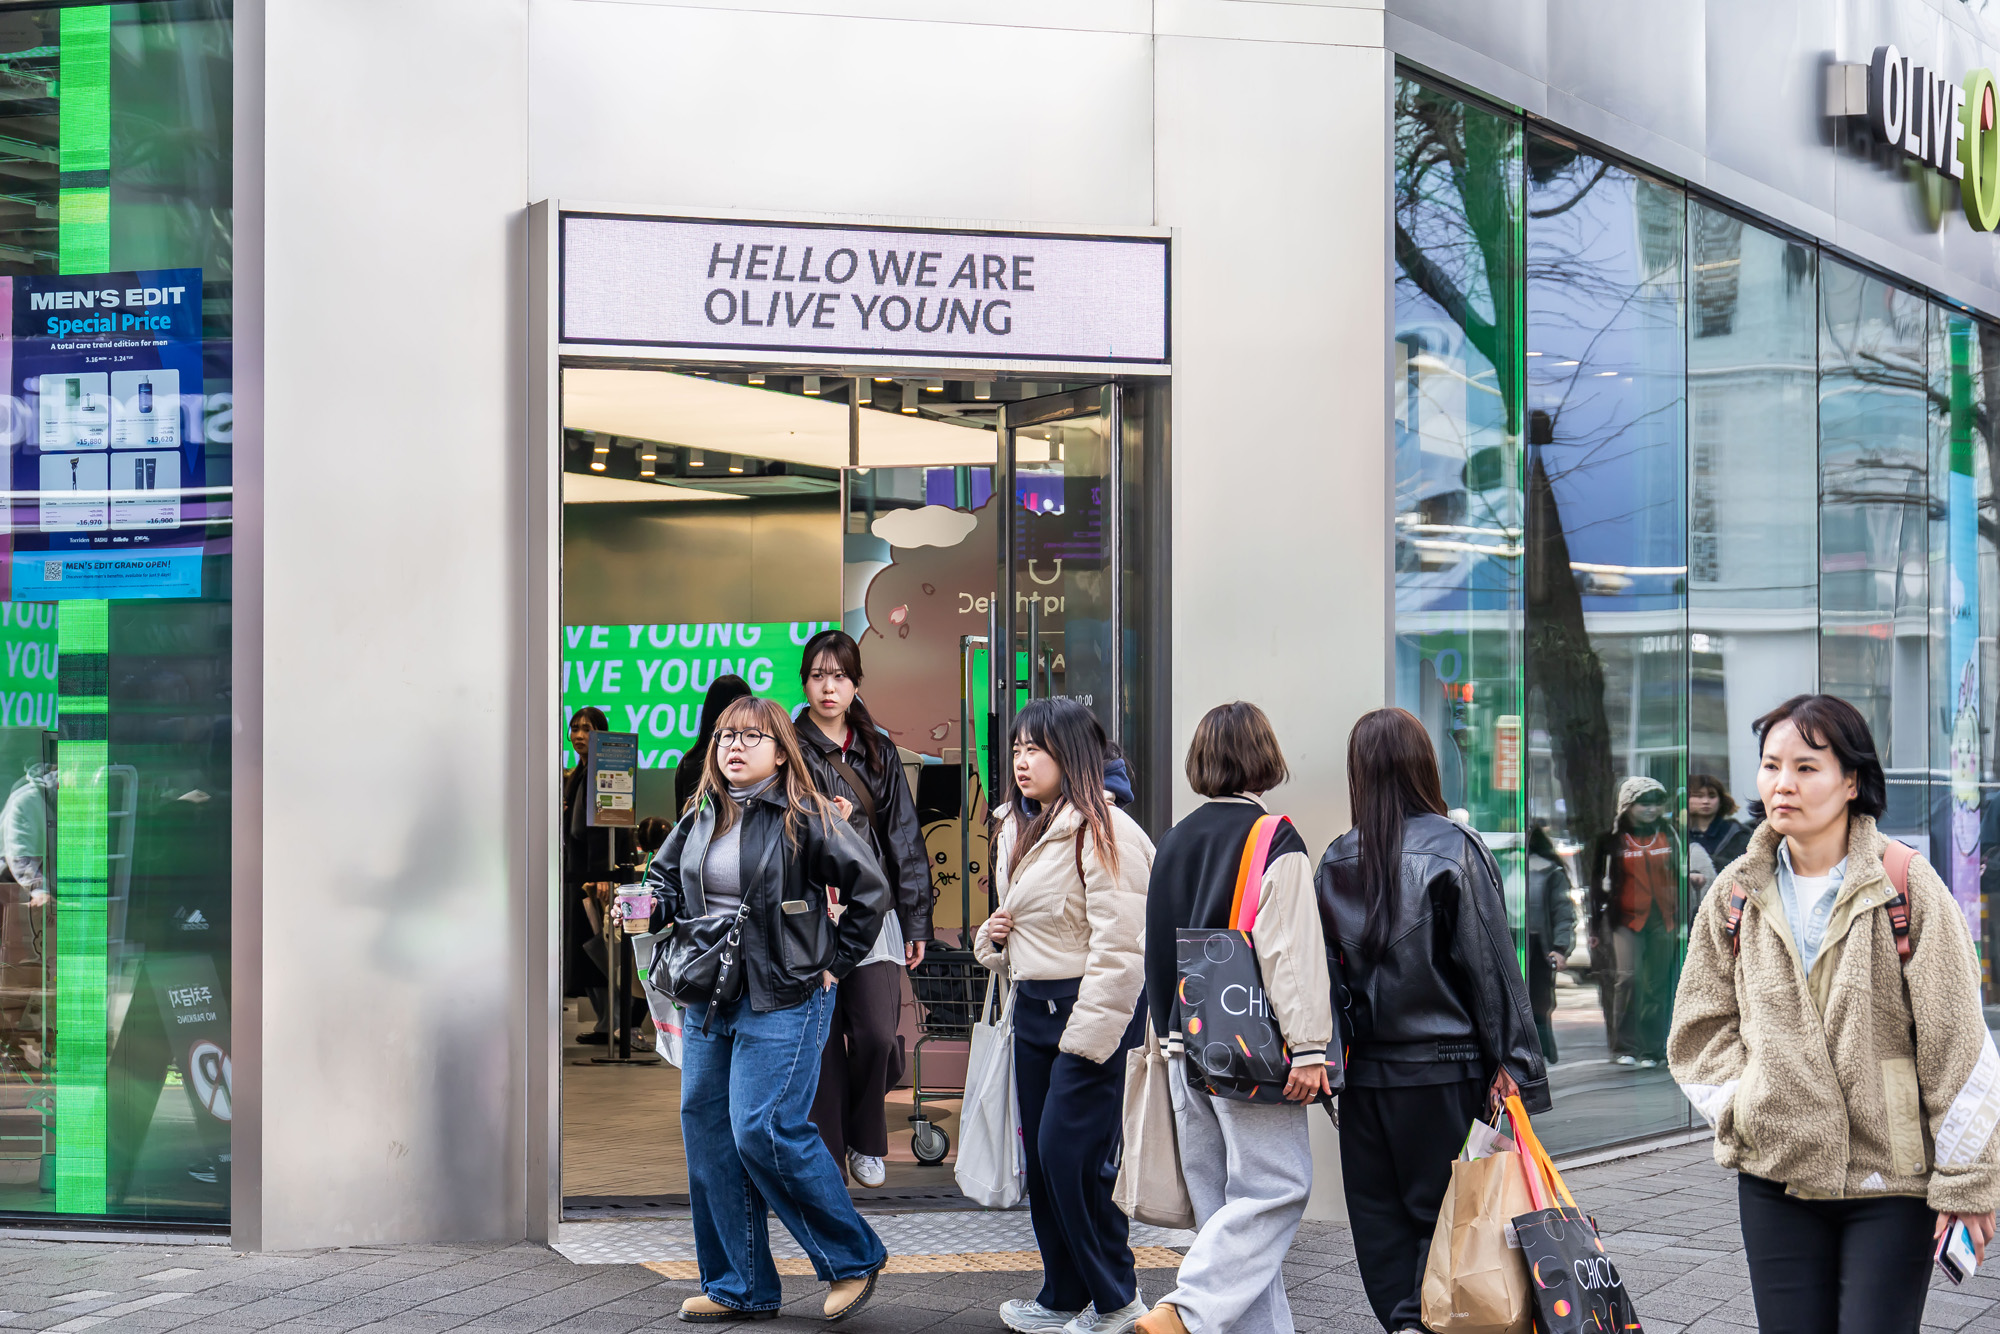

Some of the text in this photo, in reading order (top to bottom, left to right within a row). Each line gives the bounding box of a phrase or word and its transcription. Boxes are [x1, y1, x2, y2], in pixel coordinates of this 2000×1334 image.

[1872, 44, 1966, 180] OLIVE
[707, 242, 1035, 292] HELLO WE ARE
[30, 286, 186, 311] MEN'S EDIT
[704, 288, 1012, 336] OLIVE YOUNG
[47, 310, 171, 339] Special Price
[57, 342, 75, 350] total
[92, 341, 112, 349] trend
[113, 340, 140, 348] edition
[140, 339, 151, 347] for
[65, 560, 171, 570] MEN'S EDIT GRAND OPEN!
[2, 602, 58, 630] YOU
[628, 623, 762, 649] YOUNG
[563, 660, 624, 694] IVE
[0, 691, 58, 728] YOU
[1075, 694, 1093, 707] 10:00
[1221, 984, 1278, 1021] CHI
